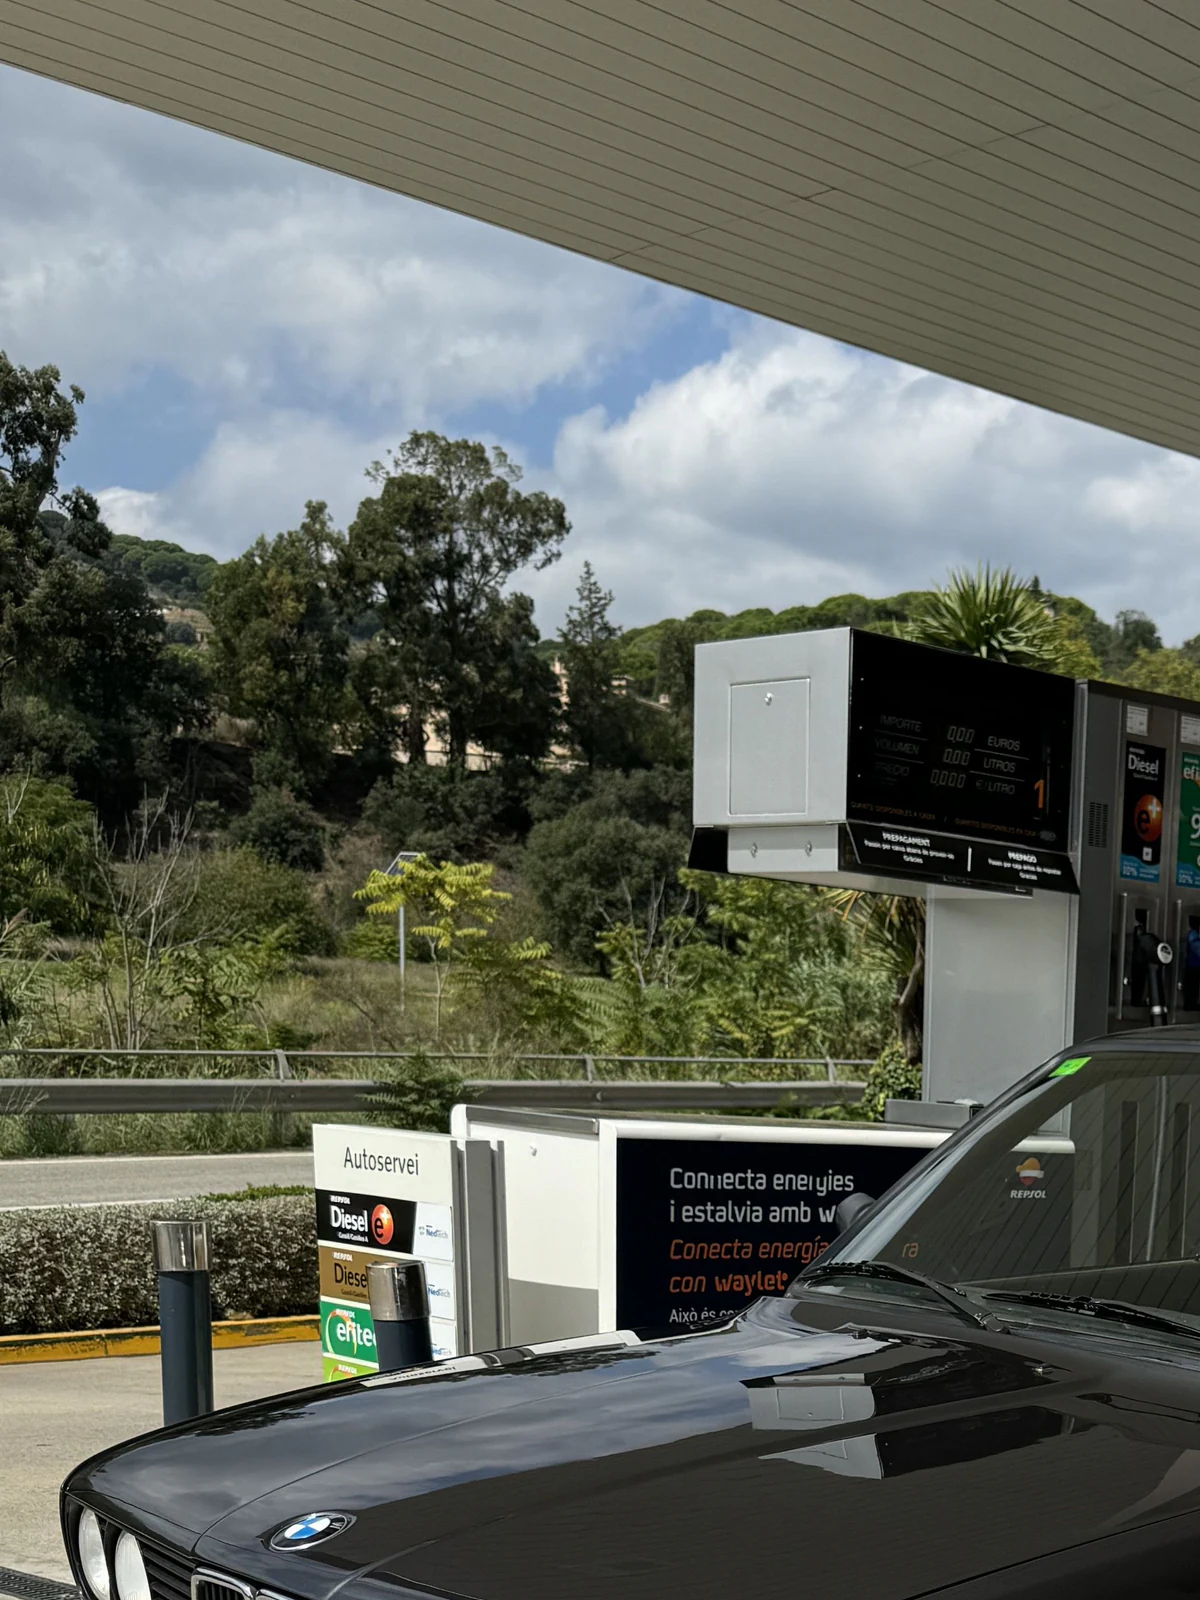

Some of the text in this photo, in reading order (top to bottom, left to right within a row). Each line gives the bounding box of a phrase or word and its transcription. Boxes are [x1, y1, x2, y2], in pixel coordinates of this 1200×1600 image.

[880, 714, 922, 733] IMPORTE
[874, 736, 920, 755] VOLUMEN
[987, 736, 1021, 752] EUROS
[875, 760, 910, 777] PRECIO
[983, 756, 1017, 773] LITROS
[1128, 754, 1159, 776] Diesel
[1034, 779, 1045, 809] 1
[882, 831, 931, 848] PREPAGAMENT
[343, 1146, 419, 1176] Autoservei
[329, 1194, 351, 1205] REPSOL
[1010, 1189, 1047, 1199] REPSOL
[329, 1205, 368, 1233] Diesel
[670, 1200, 676, 1223] i
[681, 1200, 763, 1224] estalvia
[769, 1201, 811, 1223] amb
[333, 1251, 353, 1262] REPSOL
[669, 1236, 830, 1264] Conecta energía
[334, 1262, 368, 1289] Diese
[669, 1270, 788, 1297] con waylet
[336, 1308, 356, 1319] REPSOL
[669, 1307, 698, 1326] Això
[336, 1321, 377, 1348] efite
[337, 1363, 358, 1375] REPSOL
